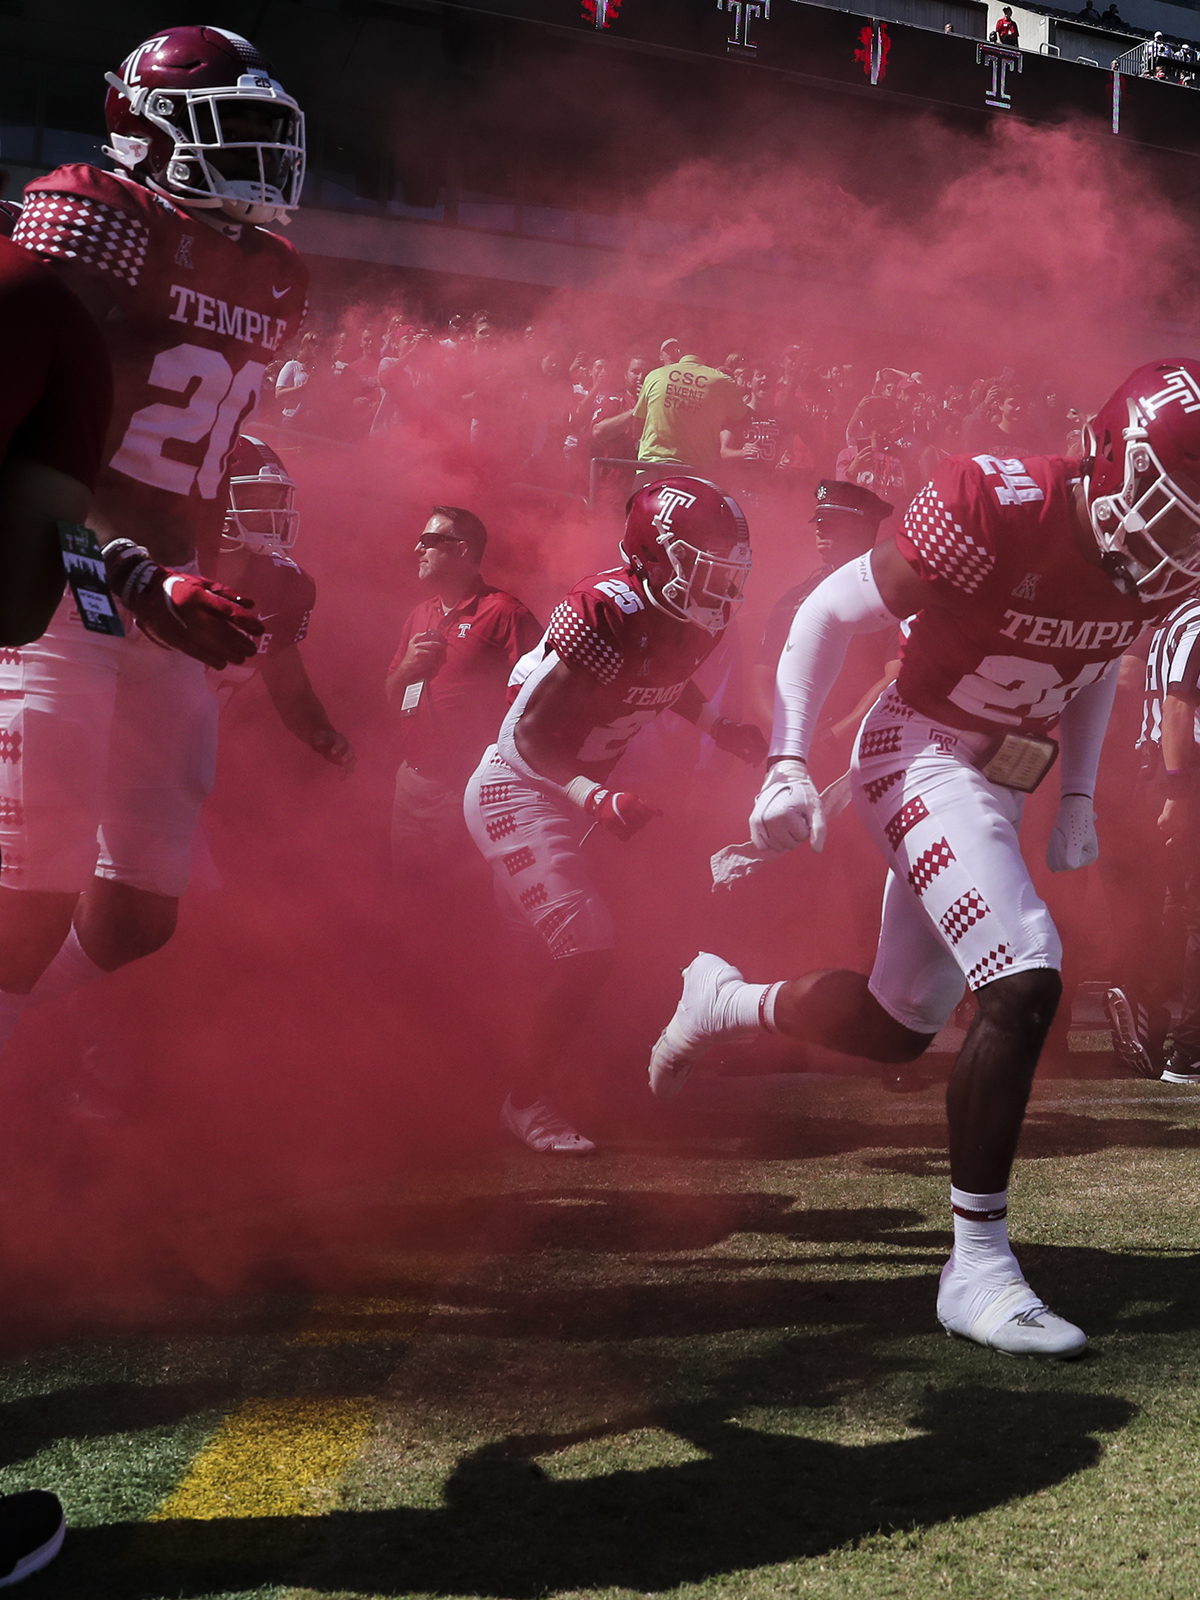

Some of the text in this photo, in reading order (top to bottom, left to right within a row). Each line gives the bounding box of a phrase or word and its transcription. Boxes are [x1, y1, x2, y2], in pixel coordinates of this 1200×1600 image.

[168, 284, 287, 351] TEMPLE
[665, 383, 706, 399] EVENT
[668, 369, 709, 389] CSC
[593, 578, 645, 615] 25
